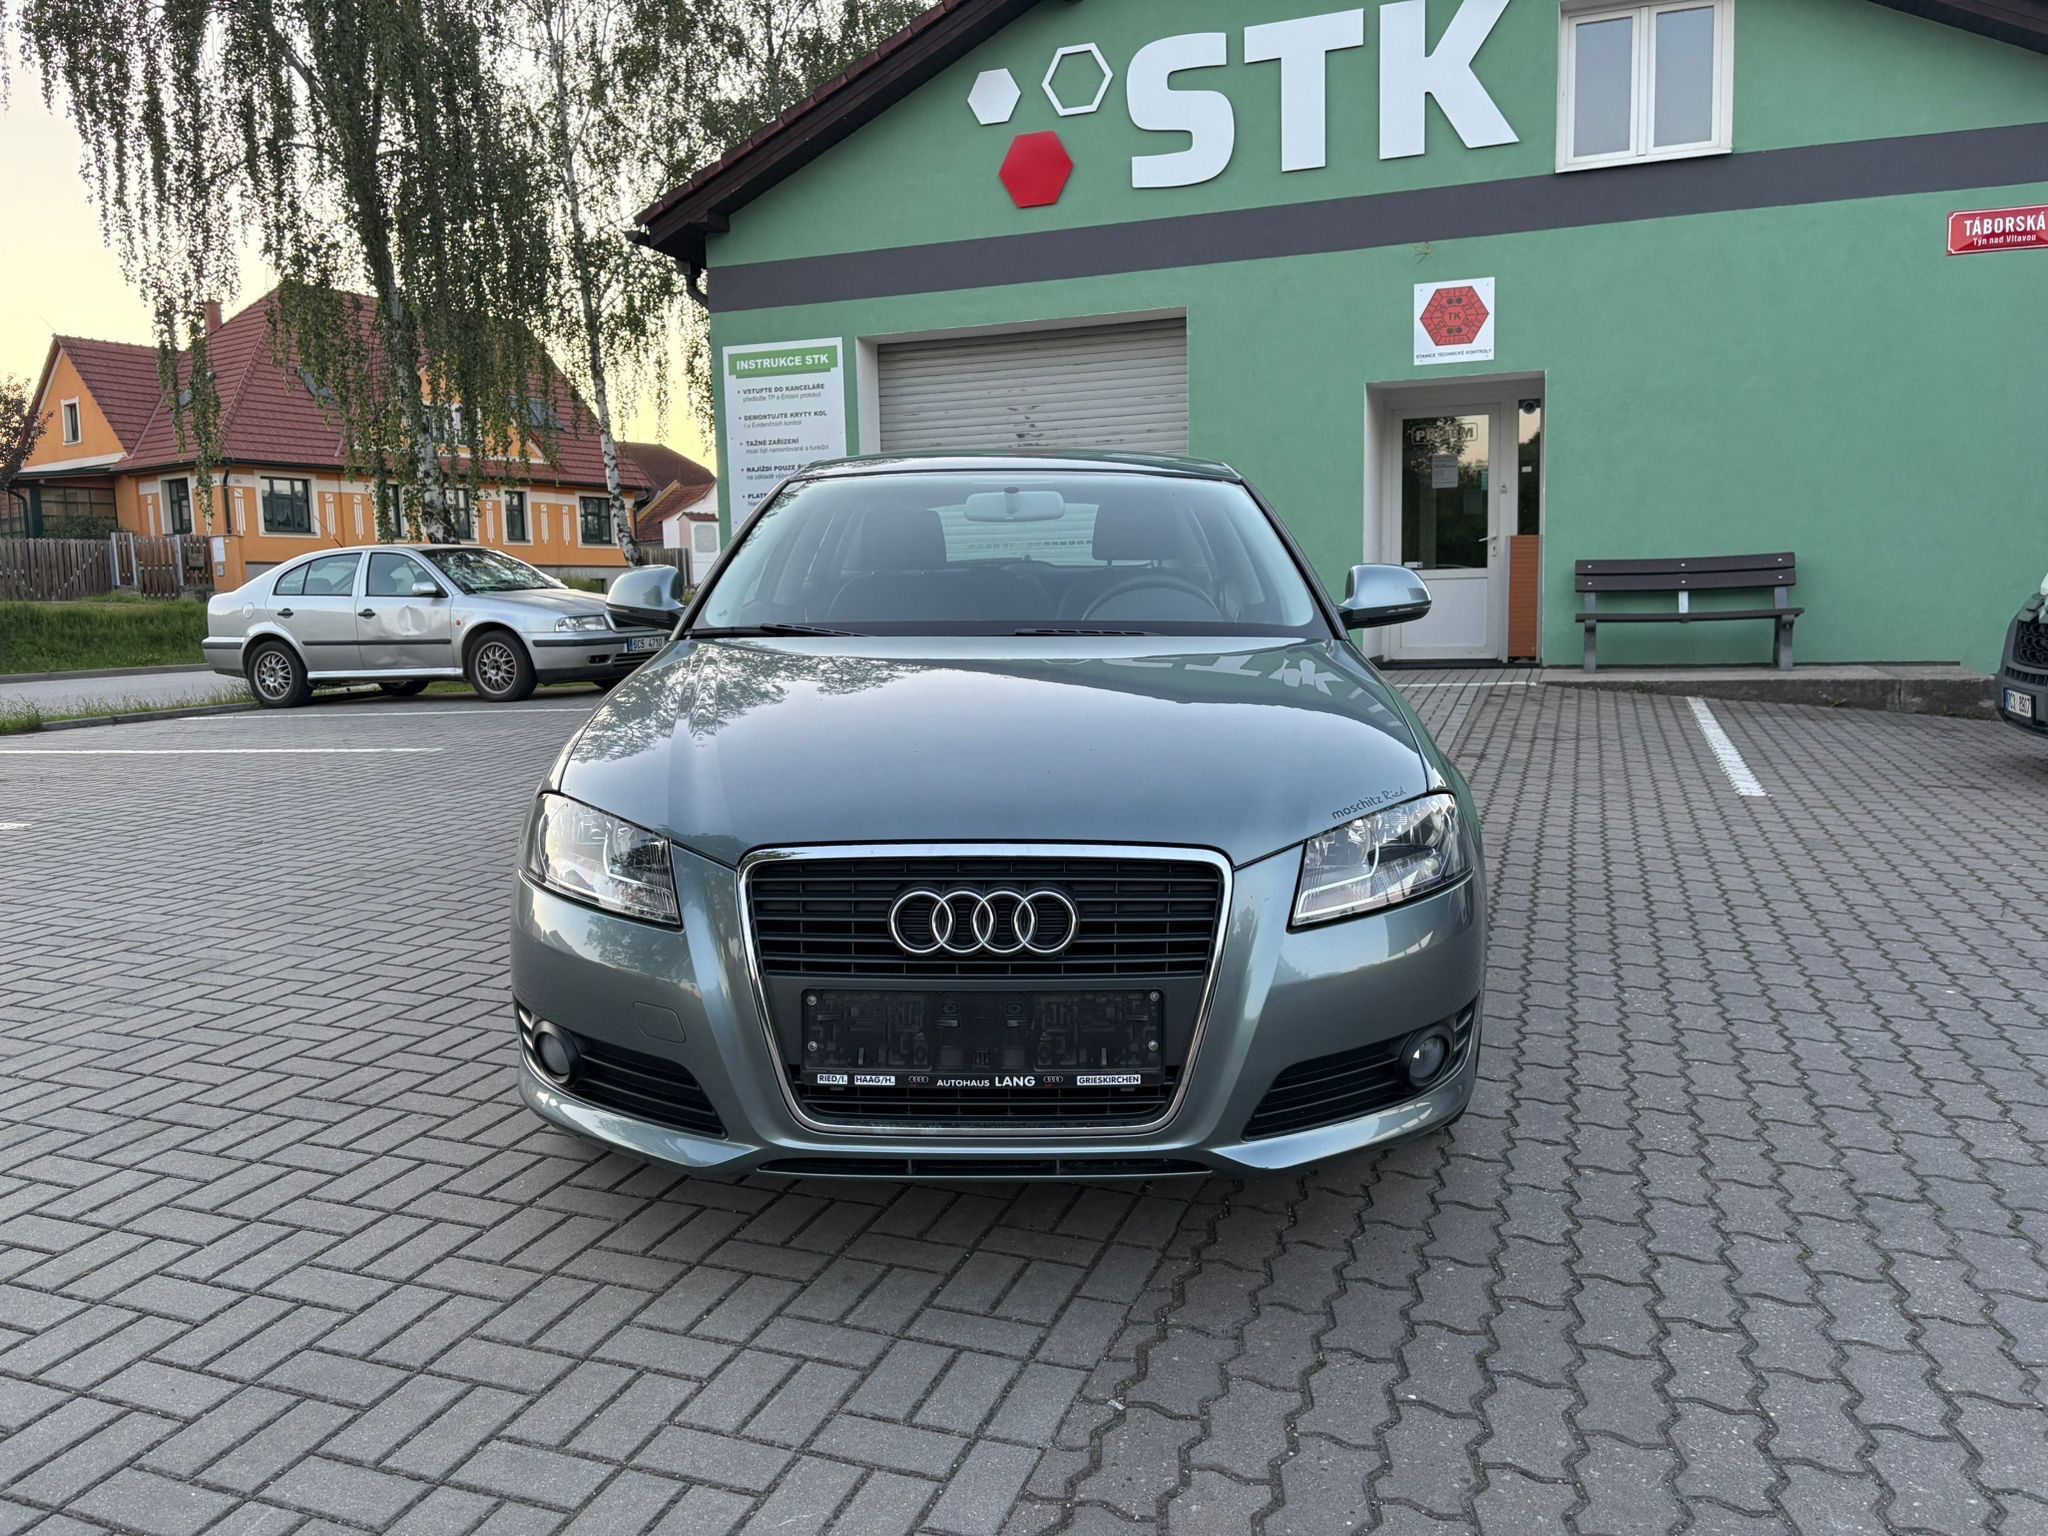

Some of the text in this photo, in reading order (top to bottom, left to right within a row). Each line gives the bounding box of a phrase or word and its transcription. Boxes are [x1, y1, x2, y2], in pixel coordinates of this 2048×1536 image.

[1126, 0, 1520, 188] STK
[1964, 211, 2046, 236] TÁBORSKÁ
[1973, 234, 2036, 247] Týn nad Vltavou
[1447, 312, 1461, 321] TK
[736, 354, 829, 370] INSTRUKCE STK
[742, 386, 773, 395] VSTUPTE
[785, 383, 825, 392] KANCELÁŘE
[743, 412, 788, 421] DEMONTUJTE
[768, 436, 799, 446] ZAŘÍZENÍ
[774, 464, 796, 472] POUZE
[1332, 795, 1384, 820] moschitz
[855, 1075, 894, 1084] HAAG/H.
[936, 1079, 990, 1087] AUTOHAUS
[995, 1076, 1036, 1087] LANG
[1078, 1075, 1140, 1084] GRIESKIRCHEN
